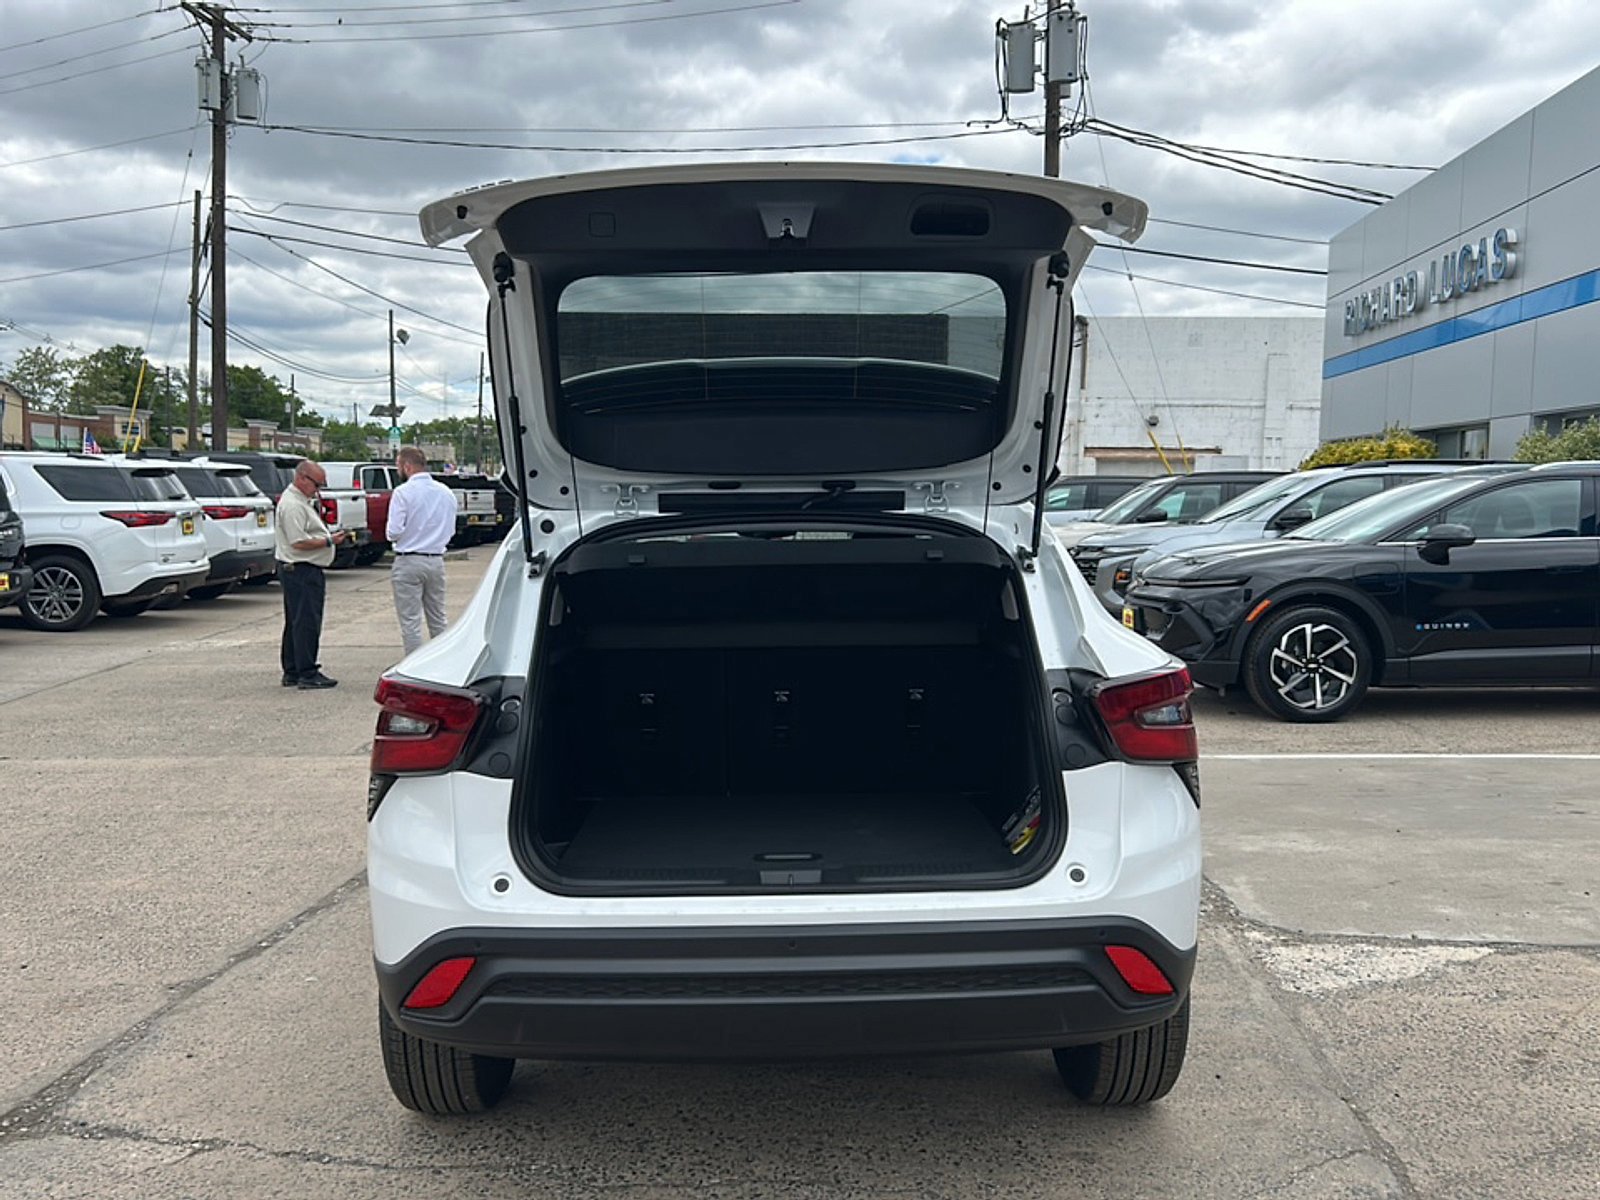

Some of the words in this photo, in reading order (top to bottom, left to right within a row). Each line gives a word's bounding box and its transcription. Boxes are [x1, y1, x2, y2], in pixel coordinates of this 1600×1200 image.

[1344, 270, 1425, 335] RICHARD
[1429, 227, 1518, 304] LUCAS
[1415, 622, 1471, 631] UINO
